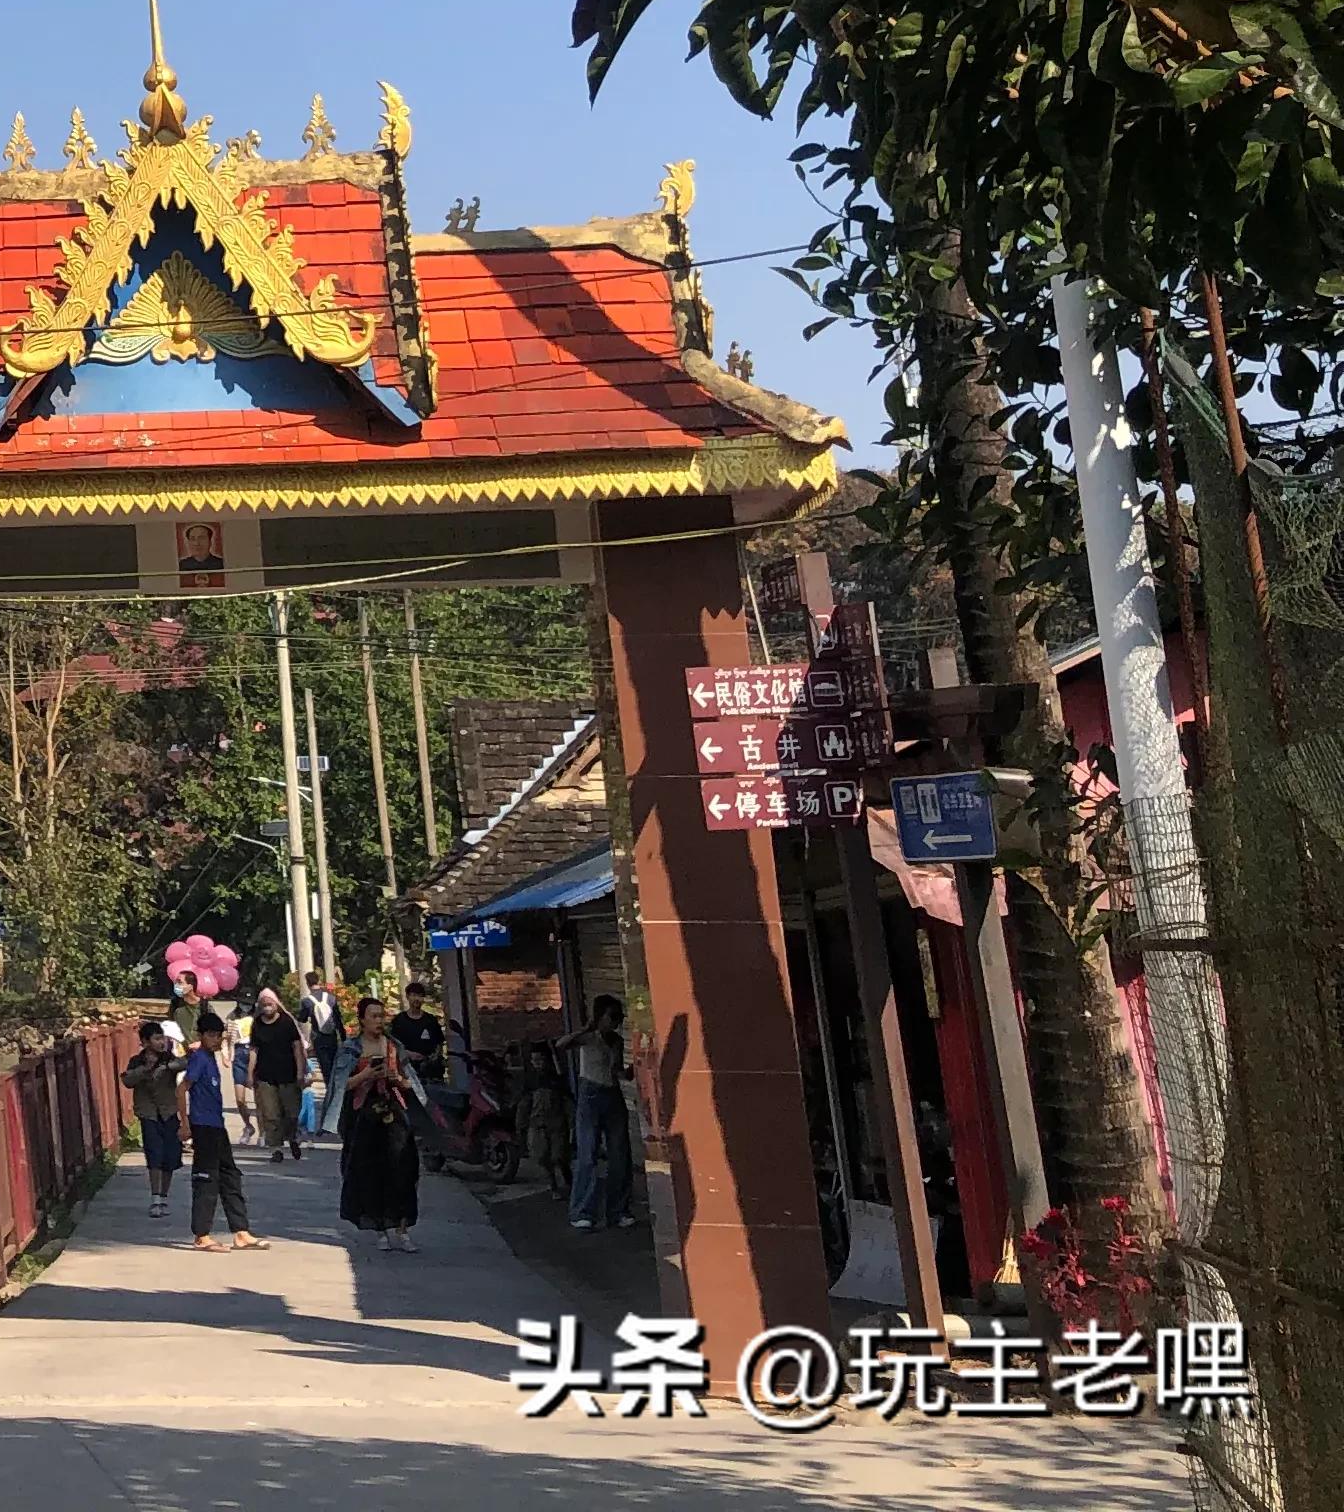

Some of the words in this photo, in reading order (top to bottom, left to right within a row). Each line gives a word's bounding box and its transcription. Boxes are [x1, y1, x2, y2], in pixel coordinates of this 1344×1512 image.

[714, 678, 807, 708] 民俗文化馆
[721, 707, 739, 716] Folk
[740, 707, 771, 715] Culture
[738, 734, 802, 762] 古井
[747, 763, 780, 771] Ancient
[735, 790, 820, 819] 停车场
[832, 786, 853, 813] P
[756, 819, 790, 828] Parking
